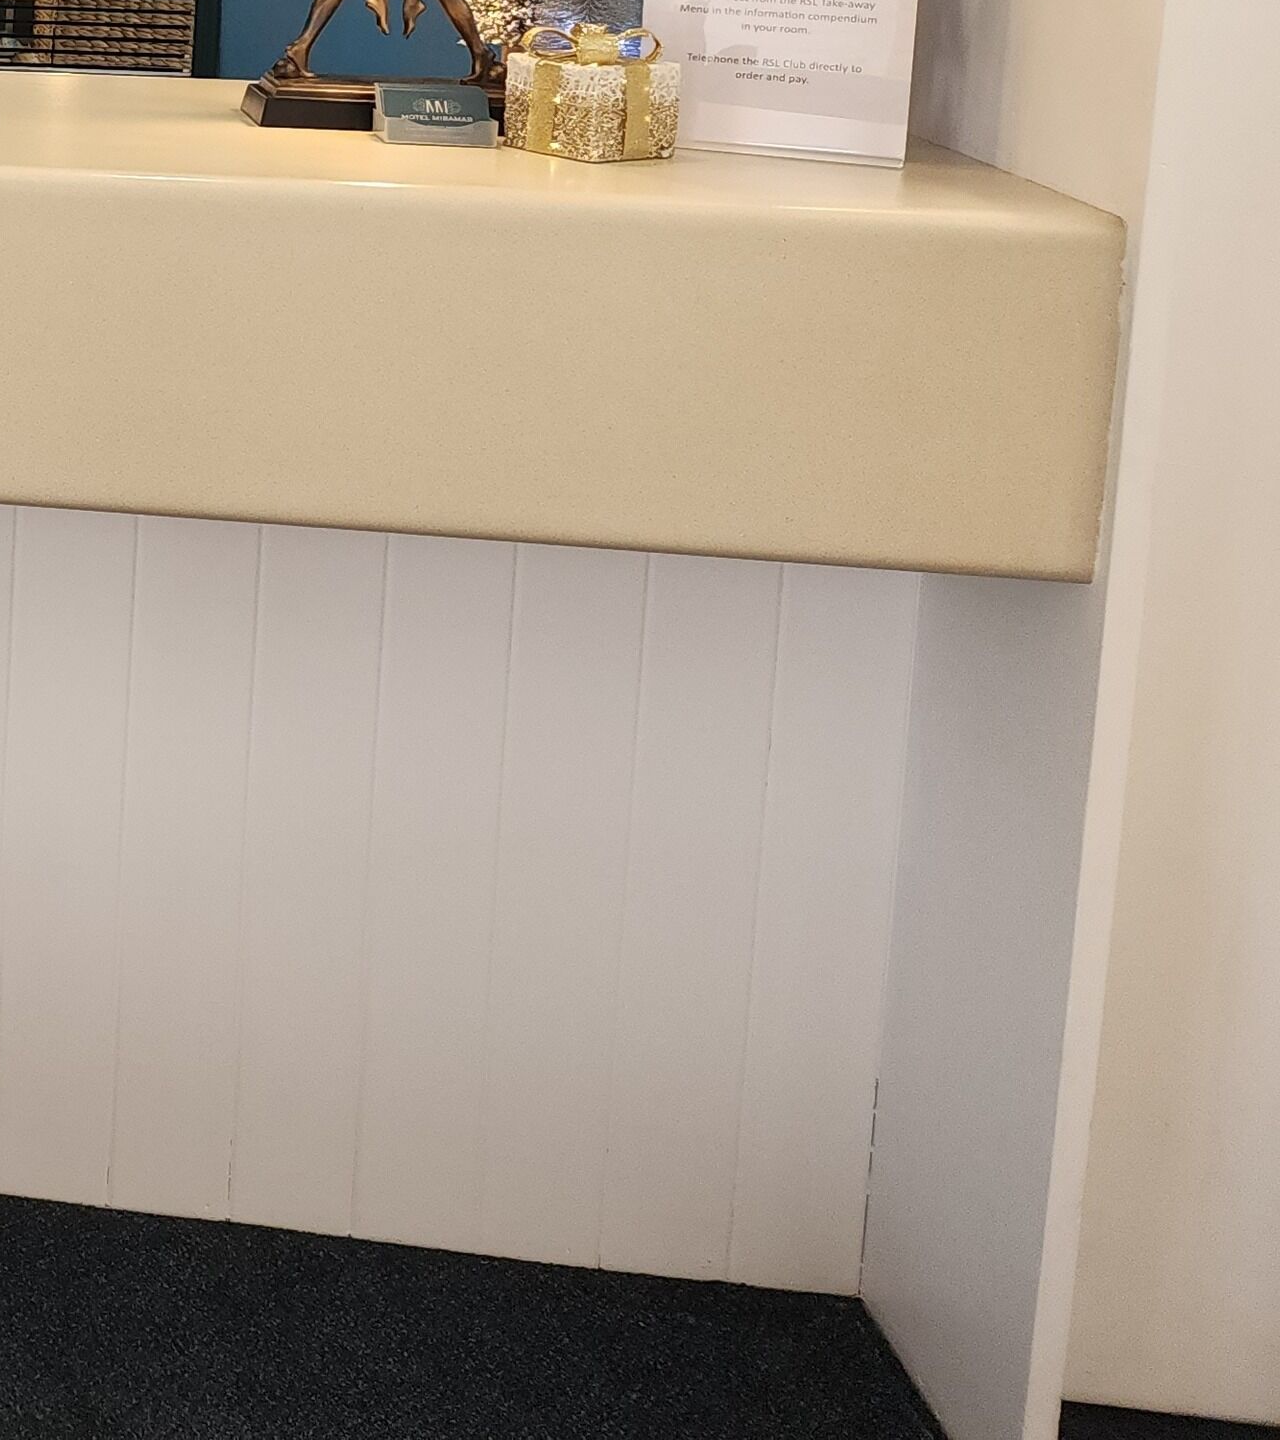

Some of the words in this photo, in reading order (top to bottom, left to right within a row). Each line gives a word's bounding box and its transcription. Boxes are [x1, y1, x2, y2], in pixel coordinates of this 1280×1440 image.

[679, 3, 709, 14] Menu
[711, 6, 722, 15] in
[724, 6, 742, 17] the
[743, 7, 806, 21] information
[807, 12, 878, 25] compendium
[740, 22, 751, 31] in
[752, 25, 777, 34] your
[779, 25, 811, 35] room.
[687, 52, 740, 65] Telephone
[741, 56, 760, 66] the
[761, 58, 781, 68] RSL
[782, 59, 807, 70] Club
[808, 61, 849, 74] directly
[850, 64, 863, 74] to
[734, 70, 764, 81] order
[766, 71, 786, 82] and
[788, 74, 809, 86] pay.
[400, 113, 431, 122] MOTEL
[431, 114, 474, 123] MIRAMAR
